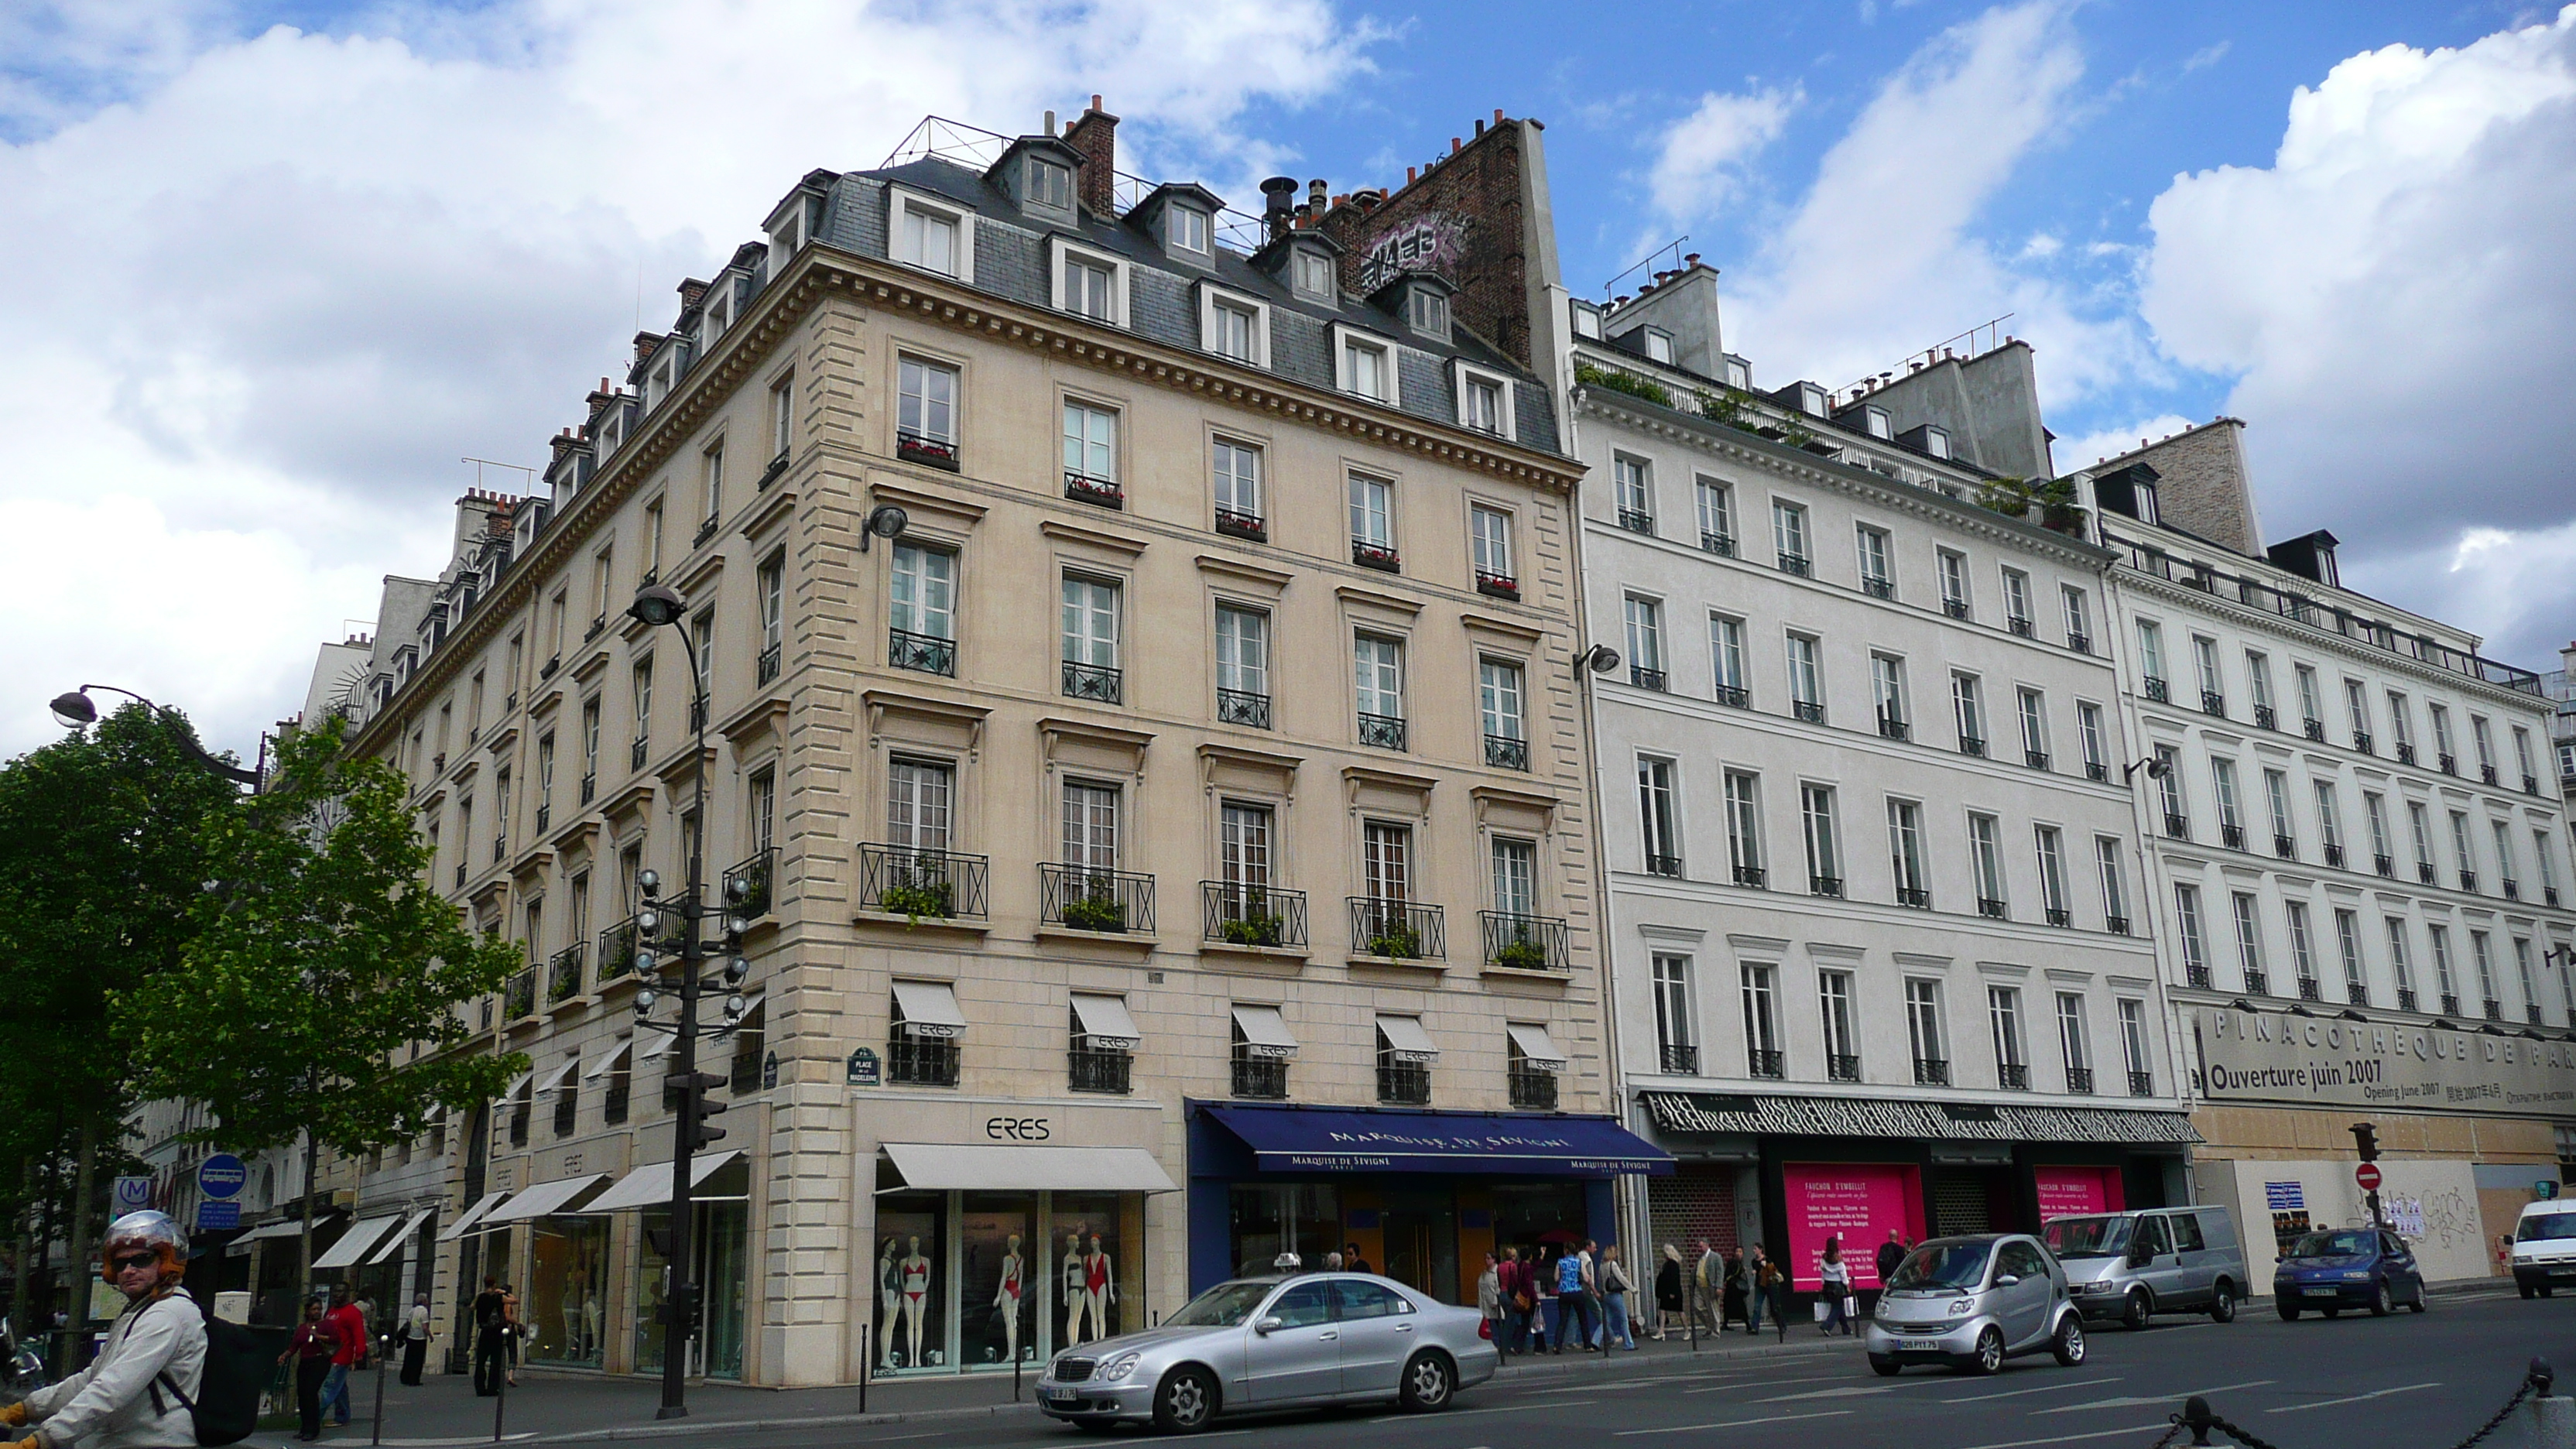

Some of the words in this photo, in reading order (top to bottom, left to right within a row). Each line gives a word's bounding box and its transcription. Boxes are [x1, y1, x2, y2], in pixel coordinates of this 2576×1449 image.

[920, 1023, 953, 1036] ERES
[1098, 1035, 1130, 1048] ERES
[2214, 1012, 2466, 1062] PINACOTHÈQUE
[2485, 1040, 2513, 1064] DE
[1261, 1045, 1288, 1056] ERES
[1405, 1051, 1430, 1061] ERES
[2211, 1064, 2307, 1090] Ouverture
[2310, 1060, 2342, 1093] juin
[2345, 1059, 2382, 1084] 2007
[2364, 1084, 2400, 1101] Opening
[2400, 1084, 2420, 1100] June
[2420, 1082, 2440, 1096] 2007
[986, 1118, 1050, 1140] ERES
[1330, 1132, 1447, 1146] MARQUISE
[1292, 1156, 1337, 1166] MARQUISE
[1571, 1161, 1607, 1170] MARQUISE
[128, 1181, 146, 1198] M
[1805, 1182, 1831, 1190] FAUCHON
